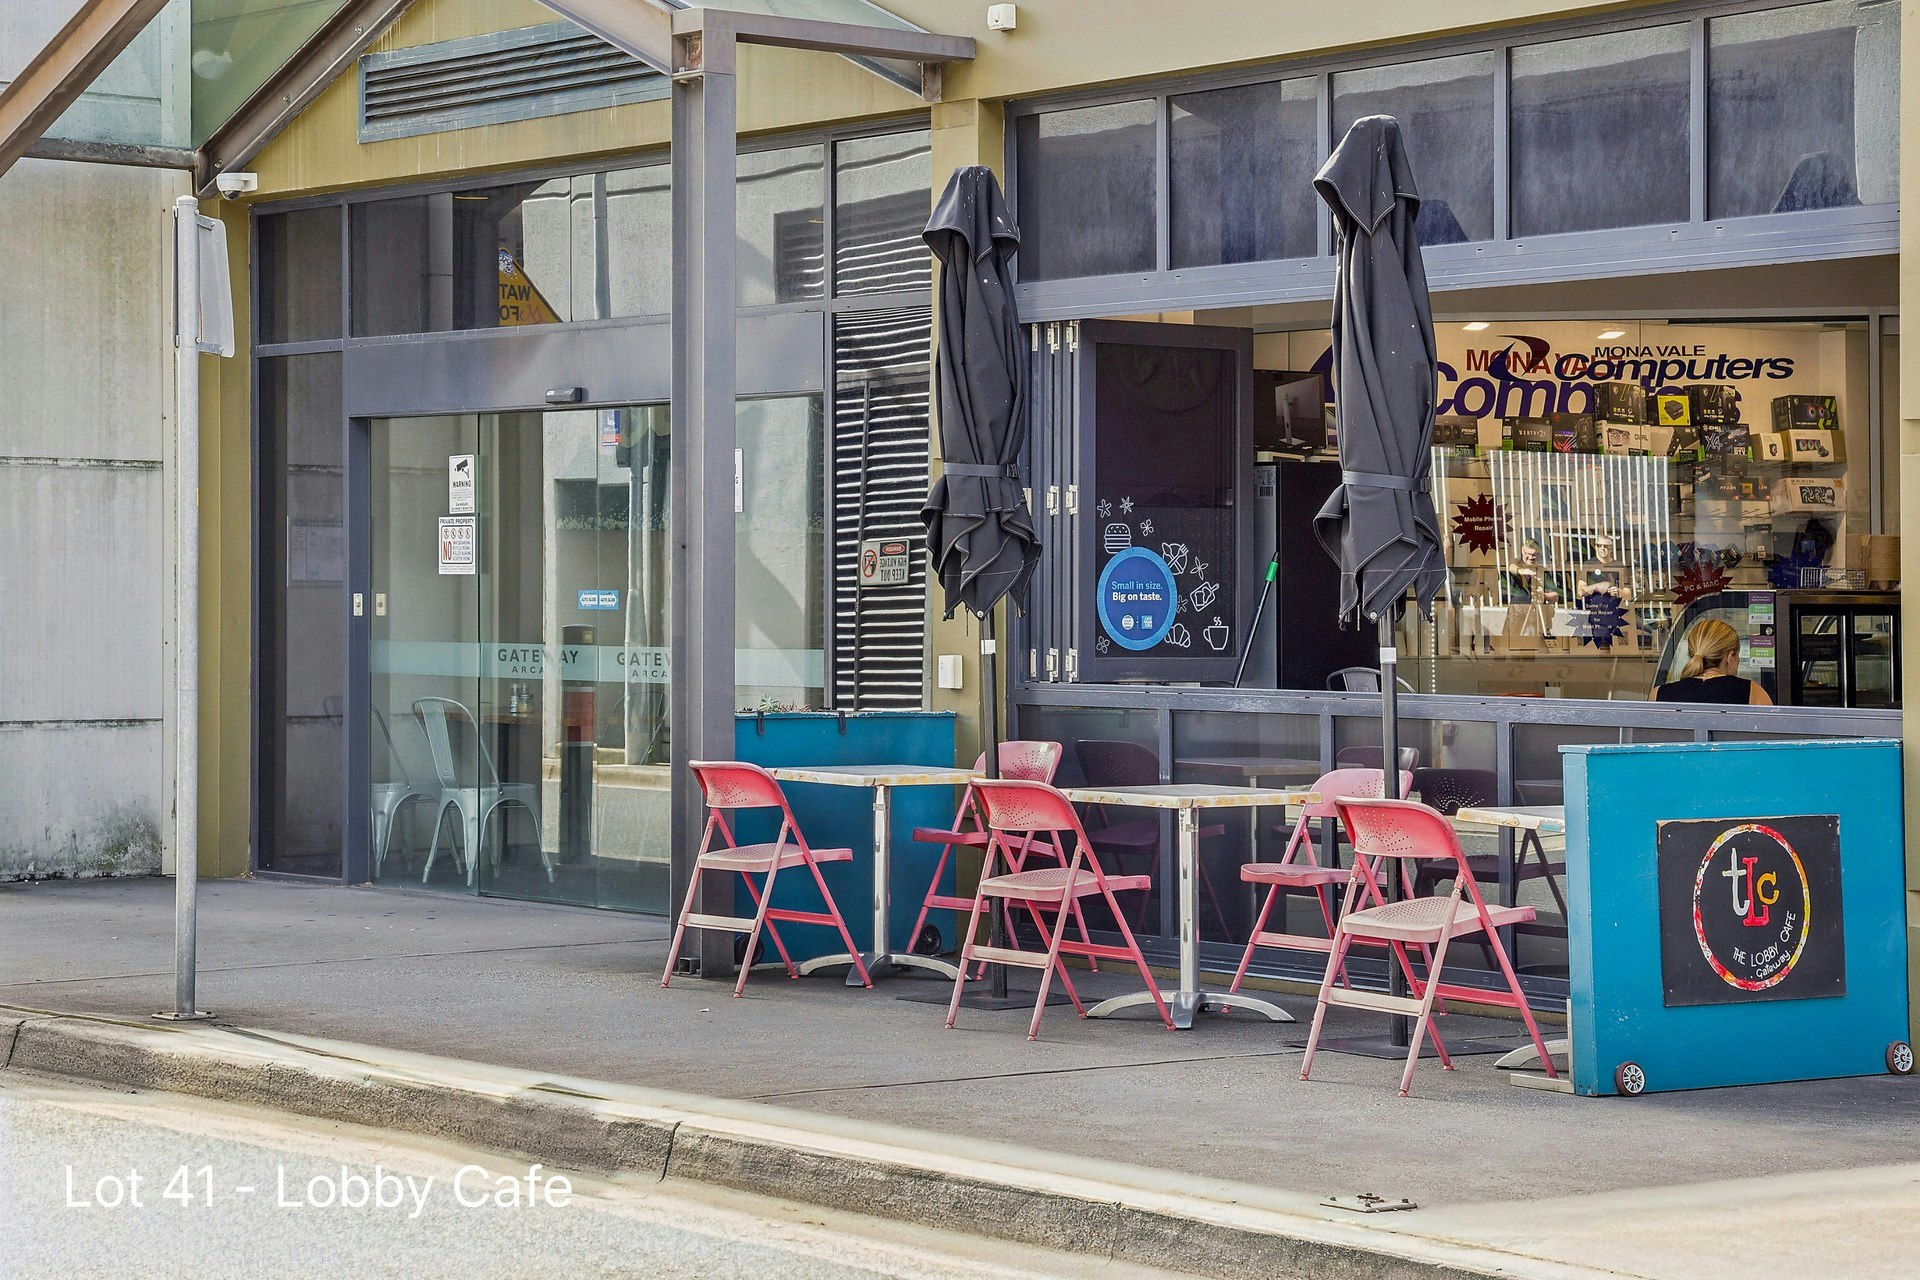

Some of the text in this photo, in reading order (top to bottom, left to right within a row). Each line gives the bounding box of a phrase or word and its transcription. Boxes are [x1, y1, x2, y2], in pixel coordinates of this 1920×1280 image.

[1595, 346, 1705, 357] MONA VALE
[443, 541, 452, 560] NO
[1112, 581, 1163, 590] Small in size.
[1703, 580, 1719, 588] MAC
[1112, 592, 1126, 602] Big
[1140, 592, 1162, 601] taste.
[498, 649, 579, 664] GATEAY
[512, 666, 563, 674] ARCAE
[1732, 911, 1796, 967] THE LOBBY CAFE
